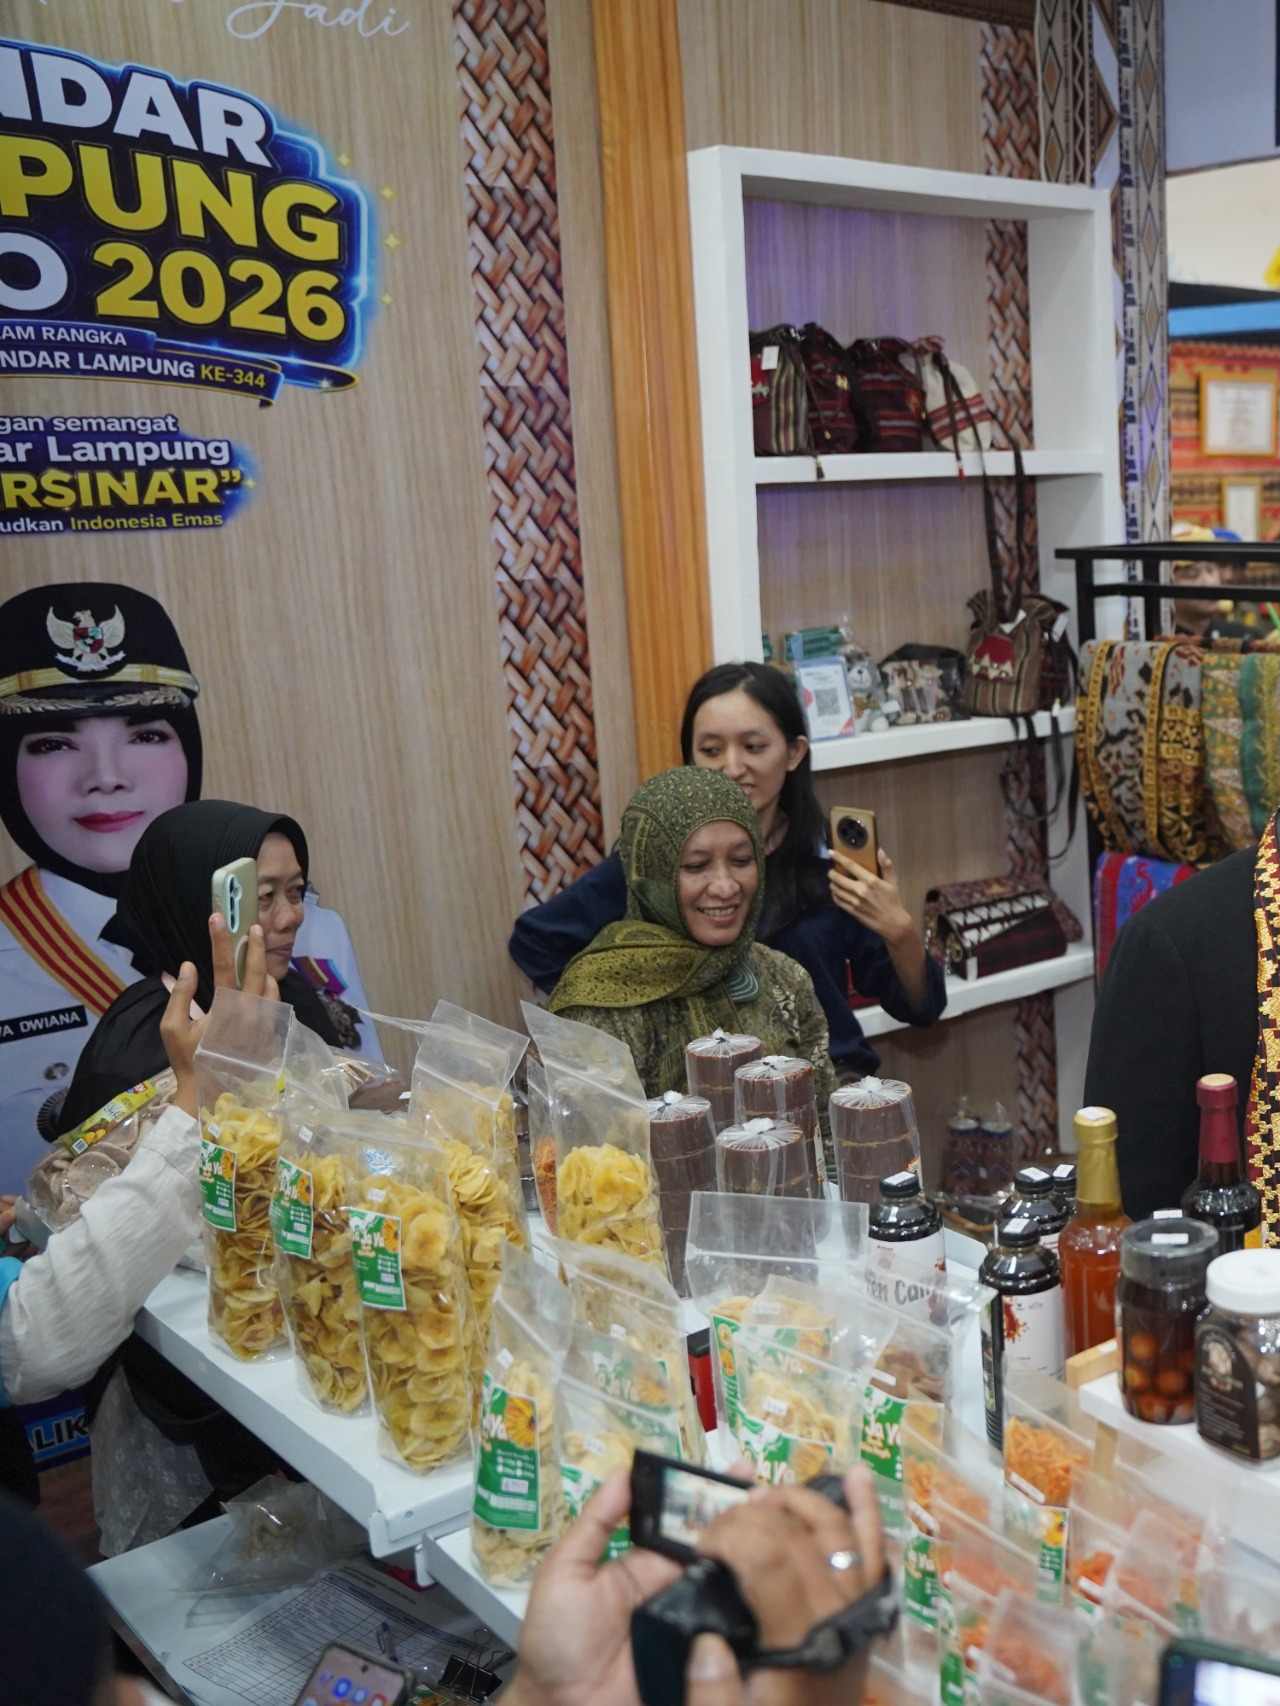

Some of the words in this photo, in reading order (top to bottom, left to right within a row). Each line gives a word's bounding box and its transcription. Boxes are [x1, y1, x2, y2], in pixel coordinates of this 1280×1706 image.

[0, 135, 341, 262] PUNG
[91, 241, 346, 342] 2026
[0, 325, 36, 341] AM
[41, 326, 128, 346] RANGKA
[78, 352, 196, 379] LAMPUNG
[200, 365, 267, 389] KE-344
[53, 415, 179, 436] semangat
[46, 435, 231, 467] Lampung
[70, 513, 167, 532] Indonesia
[172, 514, 224, 528] Emas
[19, 1010, 81, 1034] DWIANA
